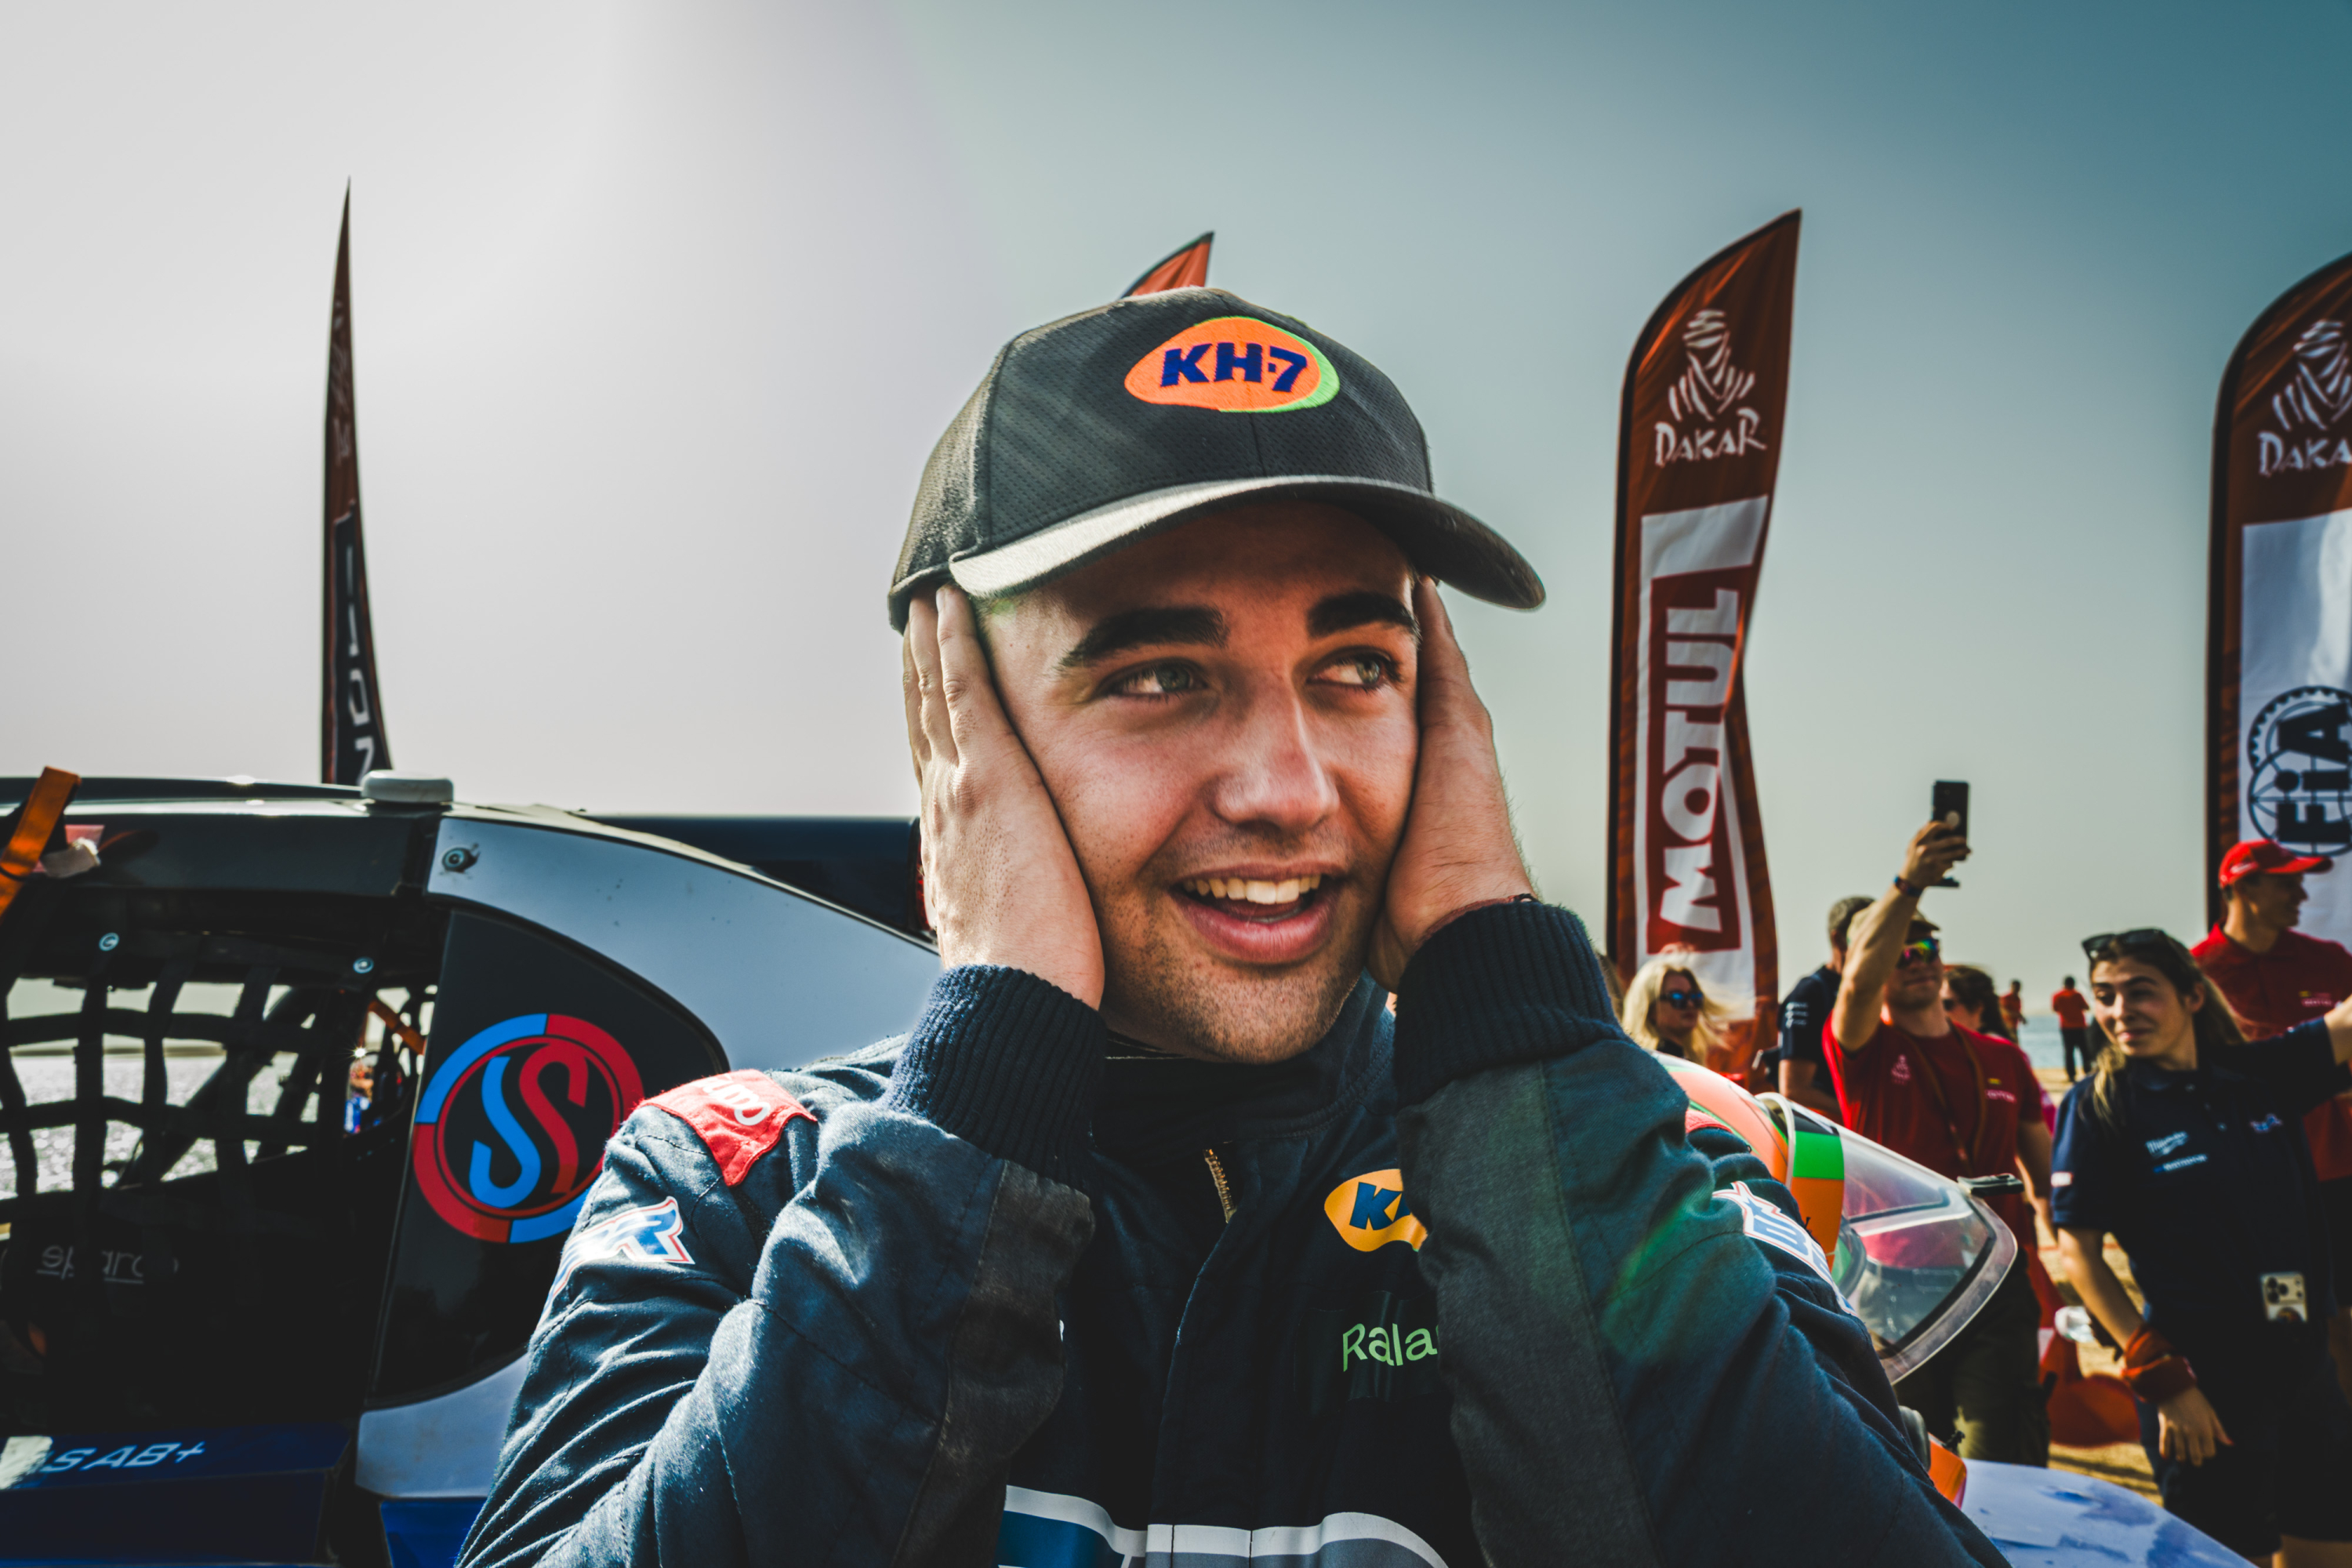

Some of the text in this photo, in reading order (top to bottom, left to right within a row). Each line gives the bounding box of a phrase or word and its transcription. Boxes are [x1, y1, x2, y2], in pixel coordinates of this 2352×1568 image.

[1654, 407, 1767, 469] DAKAR
[2258, 431, 2352, 477] DAKA
[1659, 588, 1740, 932] MOTUL
[1343, 1323, 1439, 1372] Rala
